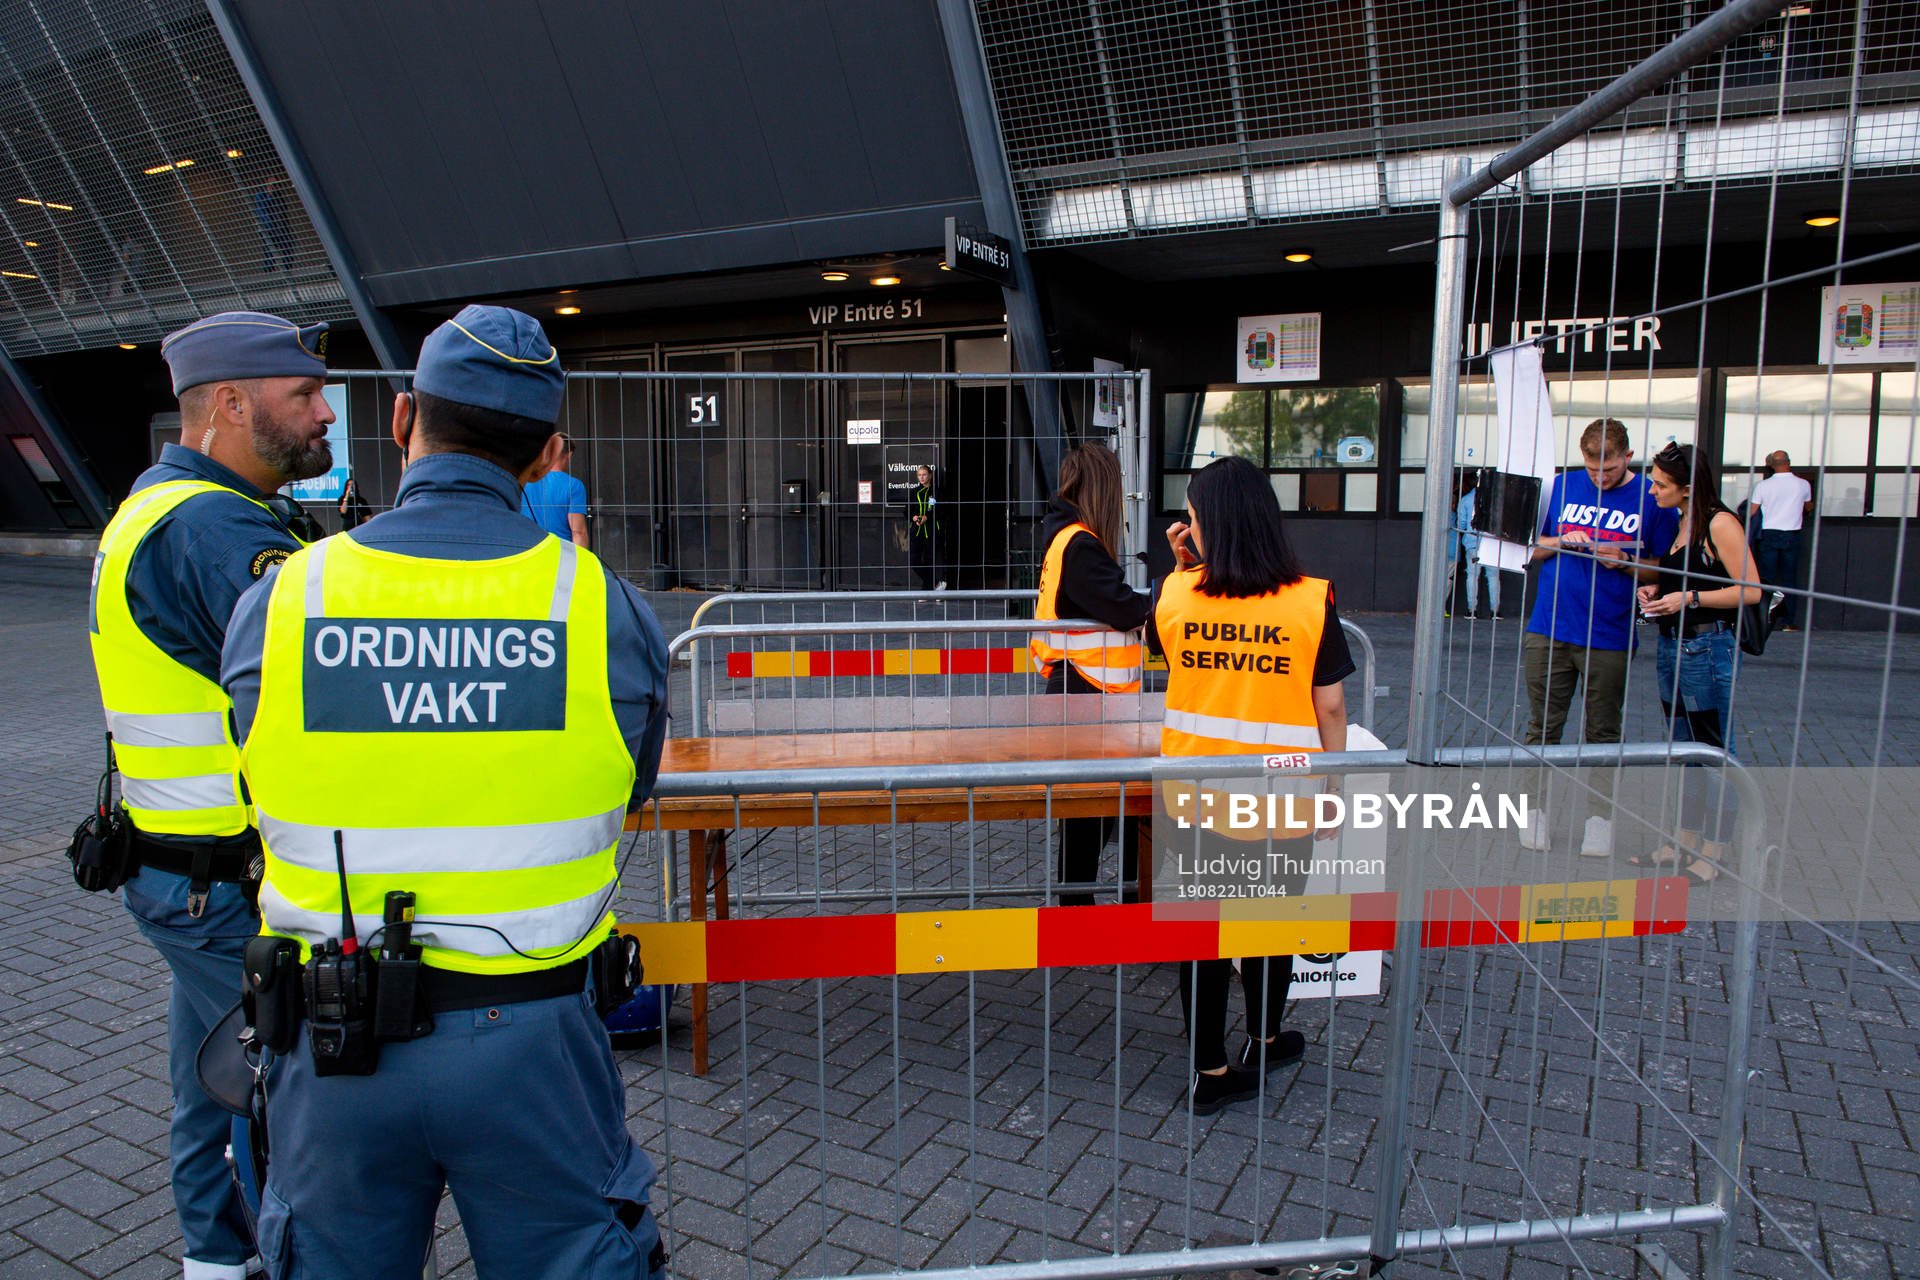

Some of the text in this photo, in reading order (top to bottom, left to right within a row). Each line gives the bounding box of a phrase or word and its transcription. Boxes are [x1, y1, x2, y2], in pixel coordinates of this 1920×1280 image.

[956, 234, 1009, 269] VIP ENTRÉ 51
[809, 298, 922, 325] VIP Entré 51
[1461, 316, 1662, 357] ILJETTER
[691, 395, 717, 423] 51
[848, 426, 879, 435] cupola
[888, 462, 936, 472] Välkomn
[1557, 503, 1609, 527] JUST
[1604, 509, 1641, 534] DO
[314, 625, 556, 668] ORDNINGS
[1184, 622, 1290, 645] PUBLIK-
[1181, 650, 1291, 675] SERVICE
[382, 681, 507, 724] VAKT
[1266, 754, 1307, 769] GdR
[1537, 896, 1618, 916] HERAS
